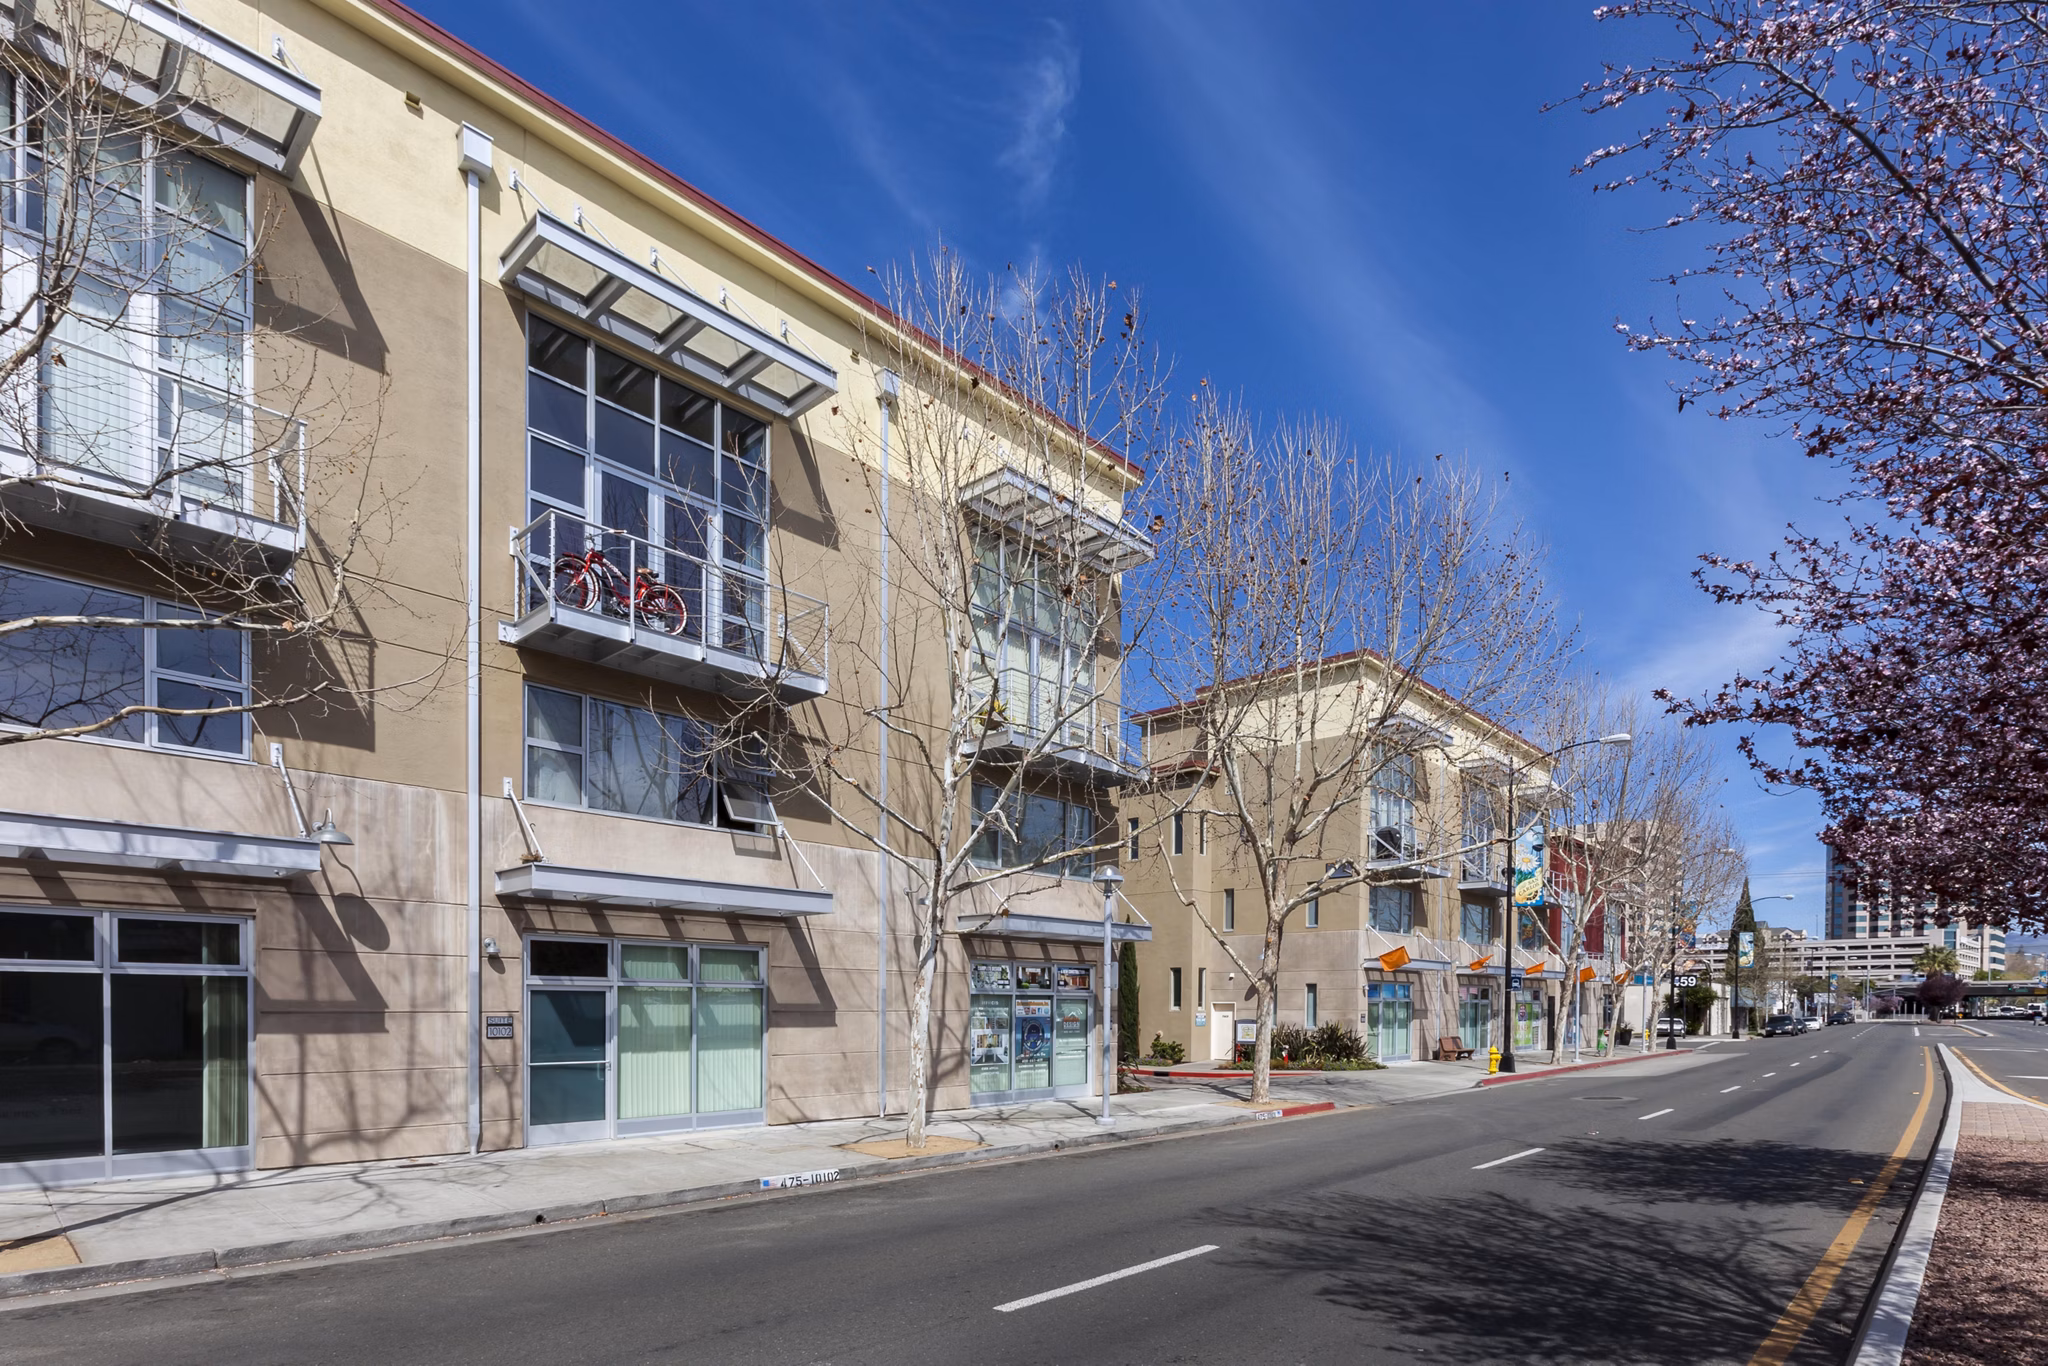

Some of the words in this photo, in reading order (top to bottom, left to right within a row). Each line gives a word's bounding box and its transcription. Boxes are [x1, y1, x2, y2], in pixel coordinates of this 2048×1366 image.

[1518, 882, 1540, 897] CARLOS
[489, 1027, 512, 1036] 10102
[780, 1170, 840, 1188] 475-10102
